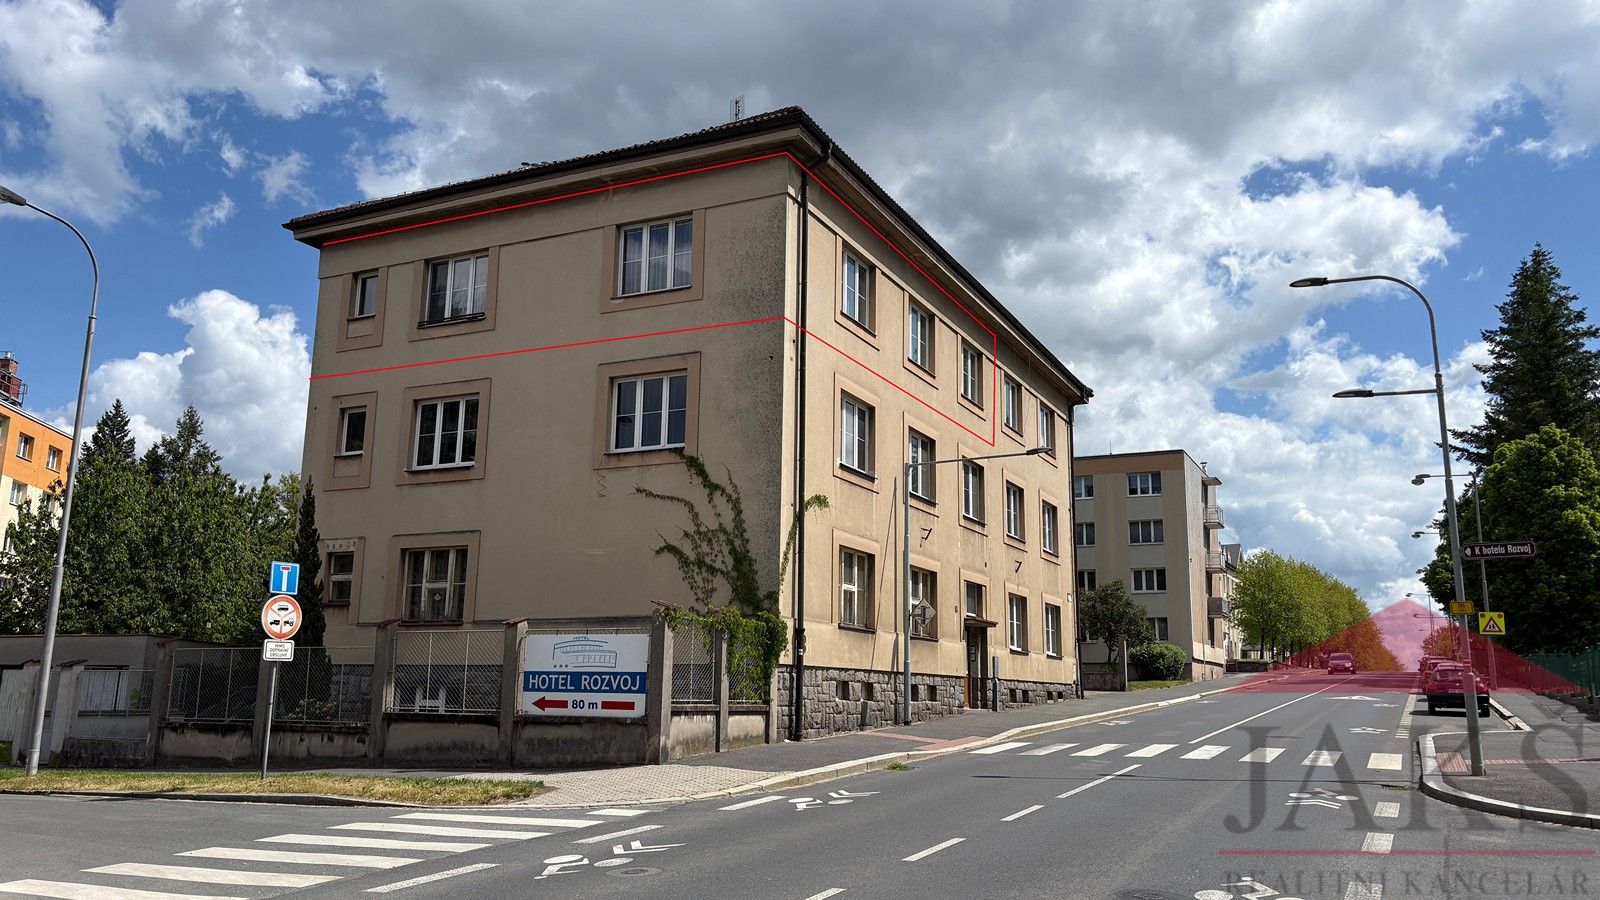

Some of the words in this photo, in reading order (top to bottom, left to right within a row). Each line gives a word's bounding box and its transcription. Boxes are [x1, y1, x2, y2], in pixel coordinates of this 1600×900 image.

[1475, 546, 1480, 555] K
[1482, 545, 1505, 555] hotelu
[1507, 544, 1531, 554] Rozvoj
[528, 674, 575, 690] HOTEL
[581, 674, 640, 691] ROZVOJ
[571, 699, 585, 709] 80
[588, 701, 598, 710] m
